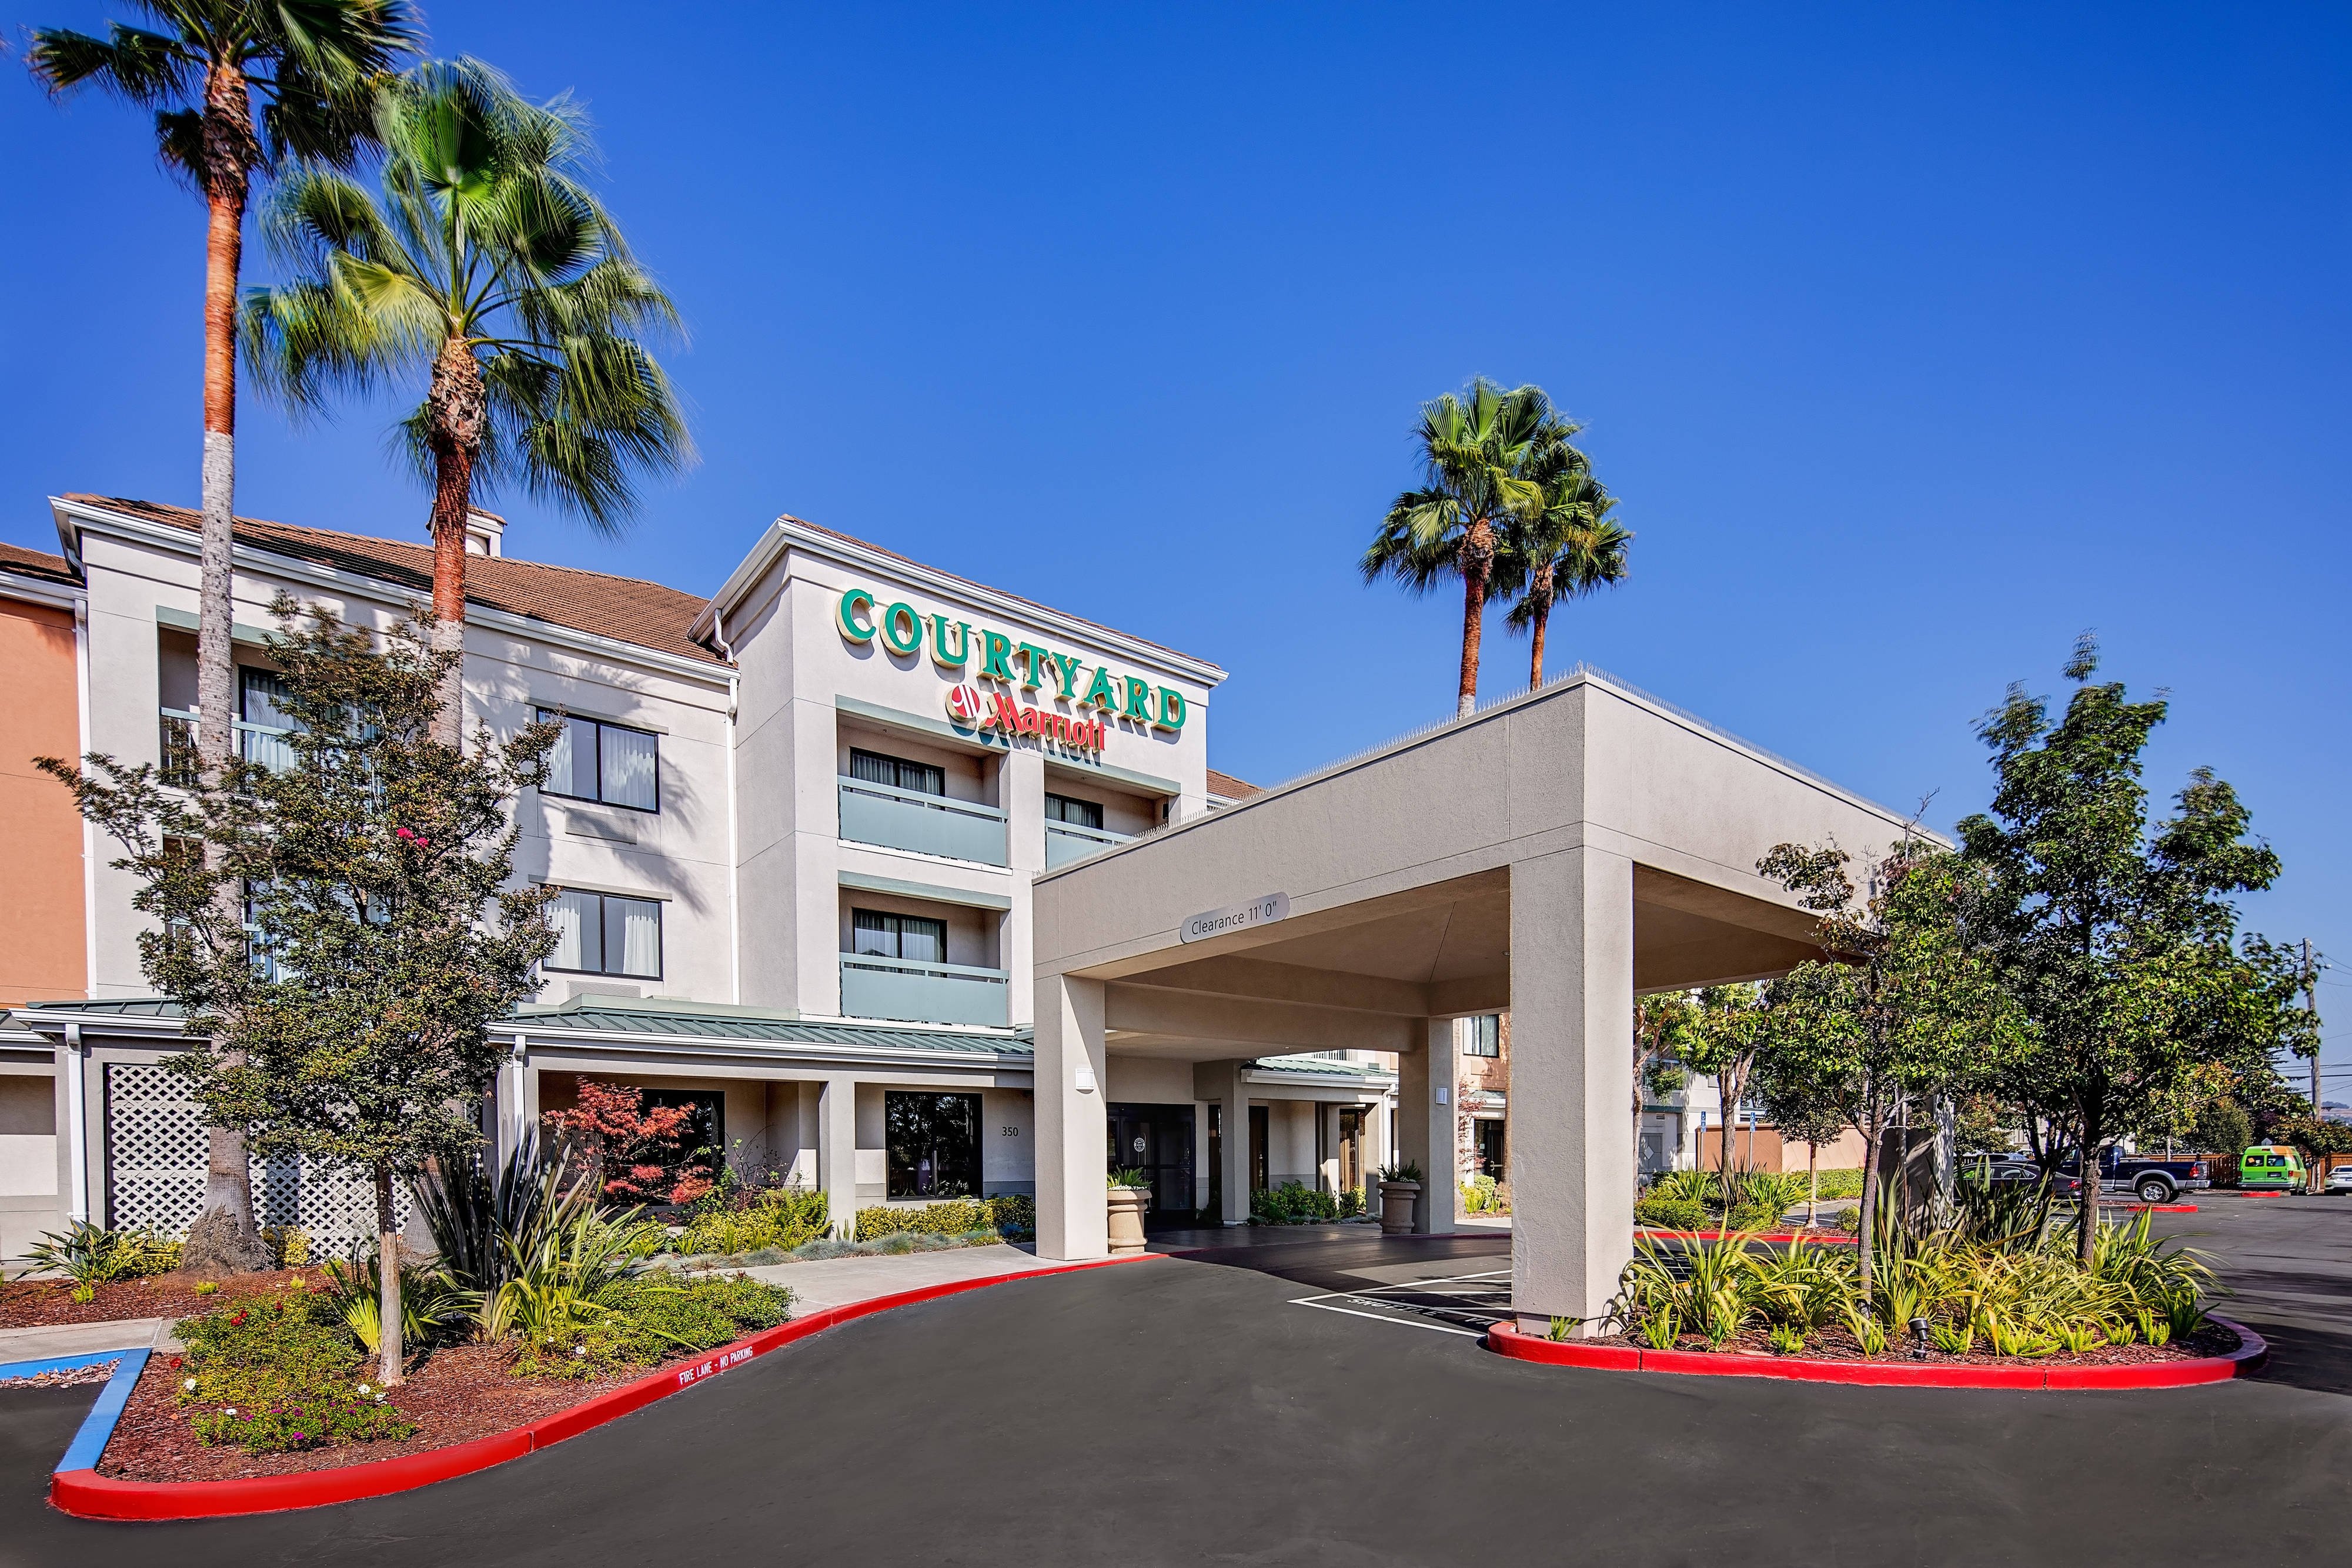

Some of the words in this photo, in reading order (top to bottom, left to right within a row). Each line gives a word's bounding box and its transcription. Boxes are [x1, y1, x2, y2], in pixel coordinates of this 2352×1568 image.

[837, 589, 1187, 731] COURTYARD
[985, 692, 1107, 751] Marriott
[1192, 914, 1244, 935] Clearance
[1002, 1126, 1018, 1136] 350
[1347, 1299, 1445, 1316] SHUTTLE
[679, 1368, 695, 1385] FIRE
[696, 1361, 713, 1378] LANE
[720, 1355, 729, 1369] NO
[730, 1346, 753, 1364] PARKING
